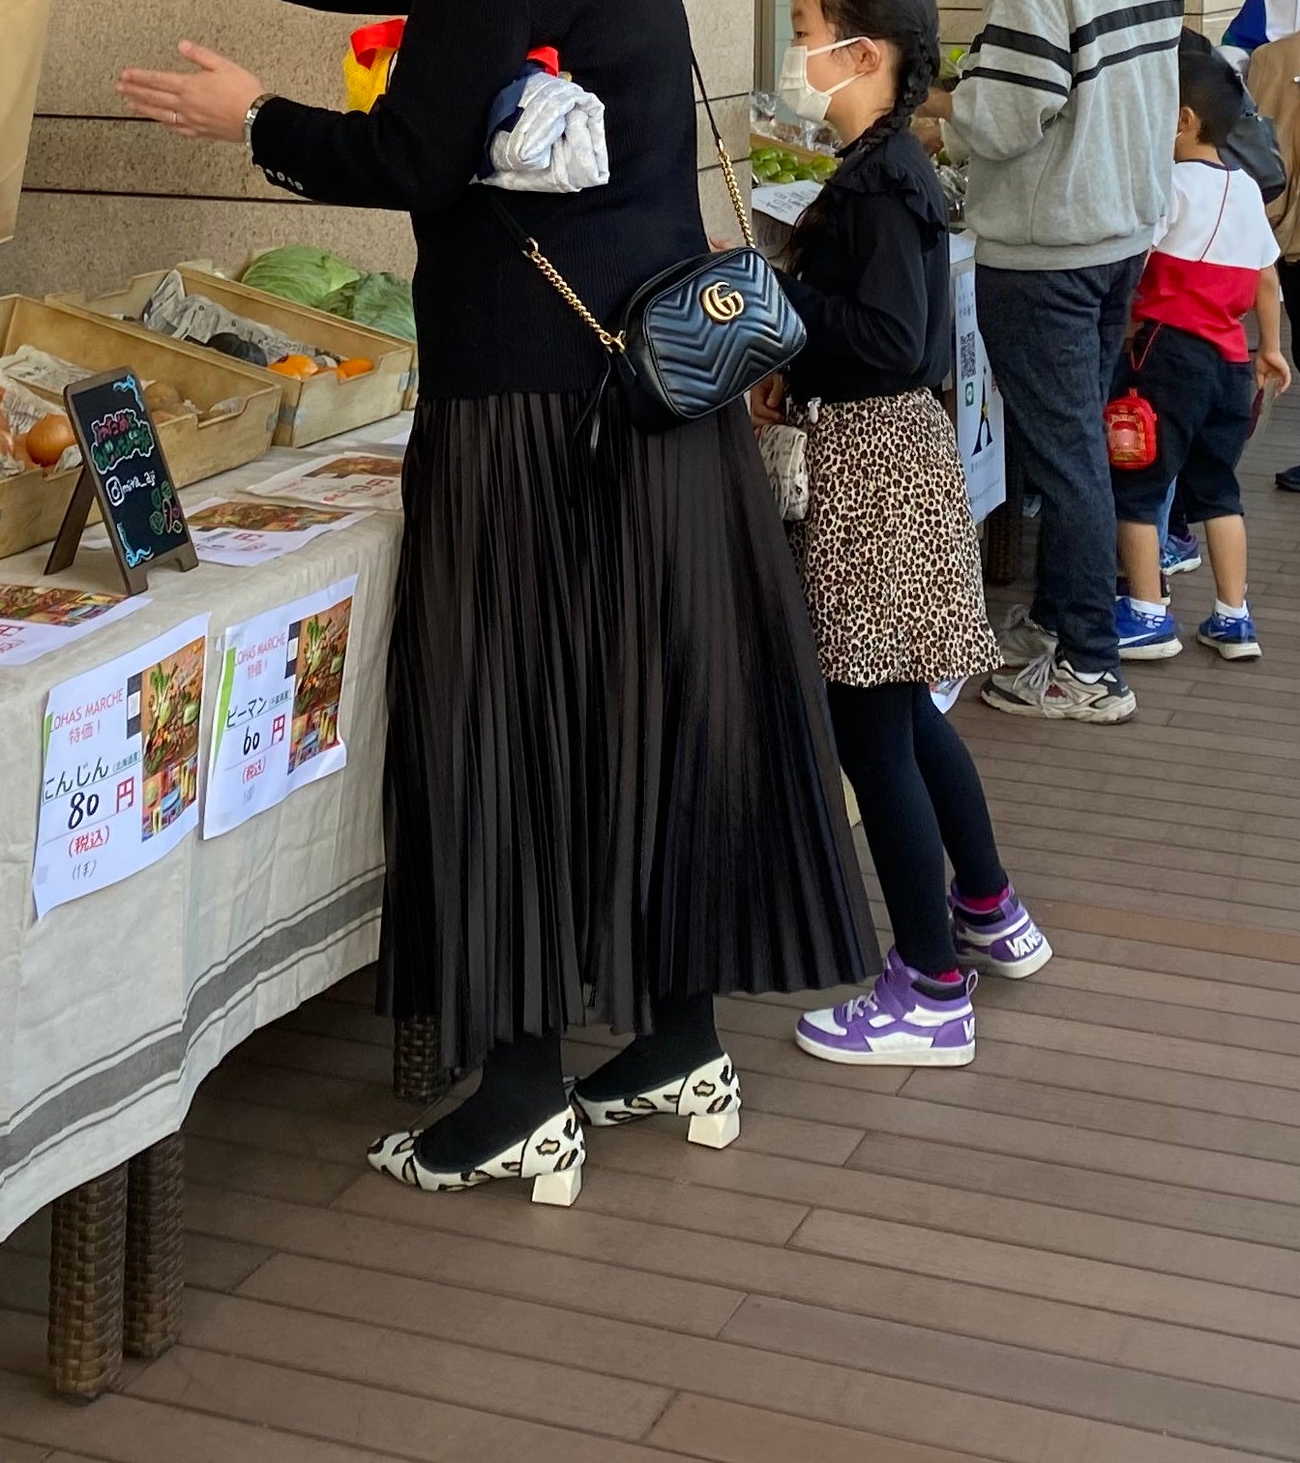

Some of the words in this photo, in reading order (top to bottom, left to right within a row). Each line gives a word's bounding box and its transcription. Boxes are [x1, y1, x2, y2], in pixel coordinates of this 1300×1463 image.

[85, 688, 125, 718] MARCHE
[243, 725, 260, 756] 60
[271, 714, 286, 746] 円
[68, 791, 100, 830] 80
[116, 776, 135, 814] 円
